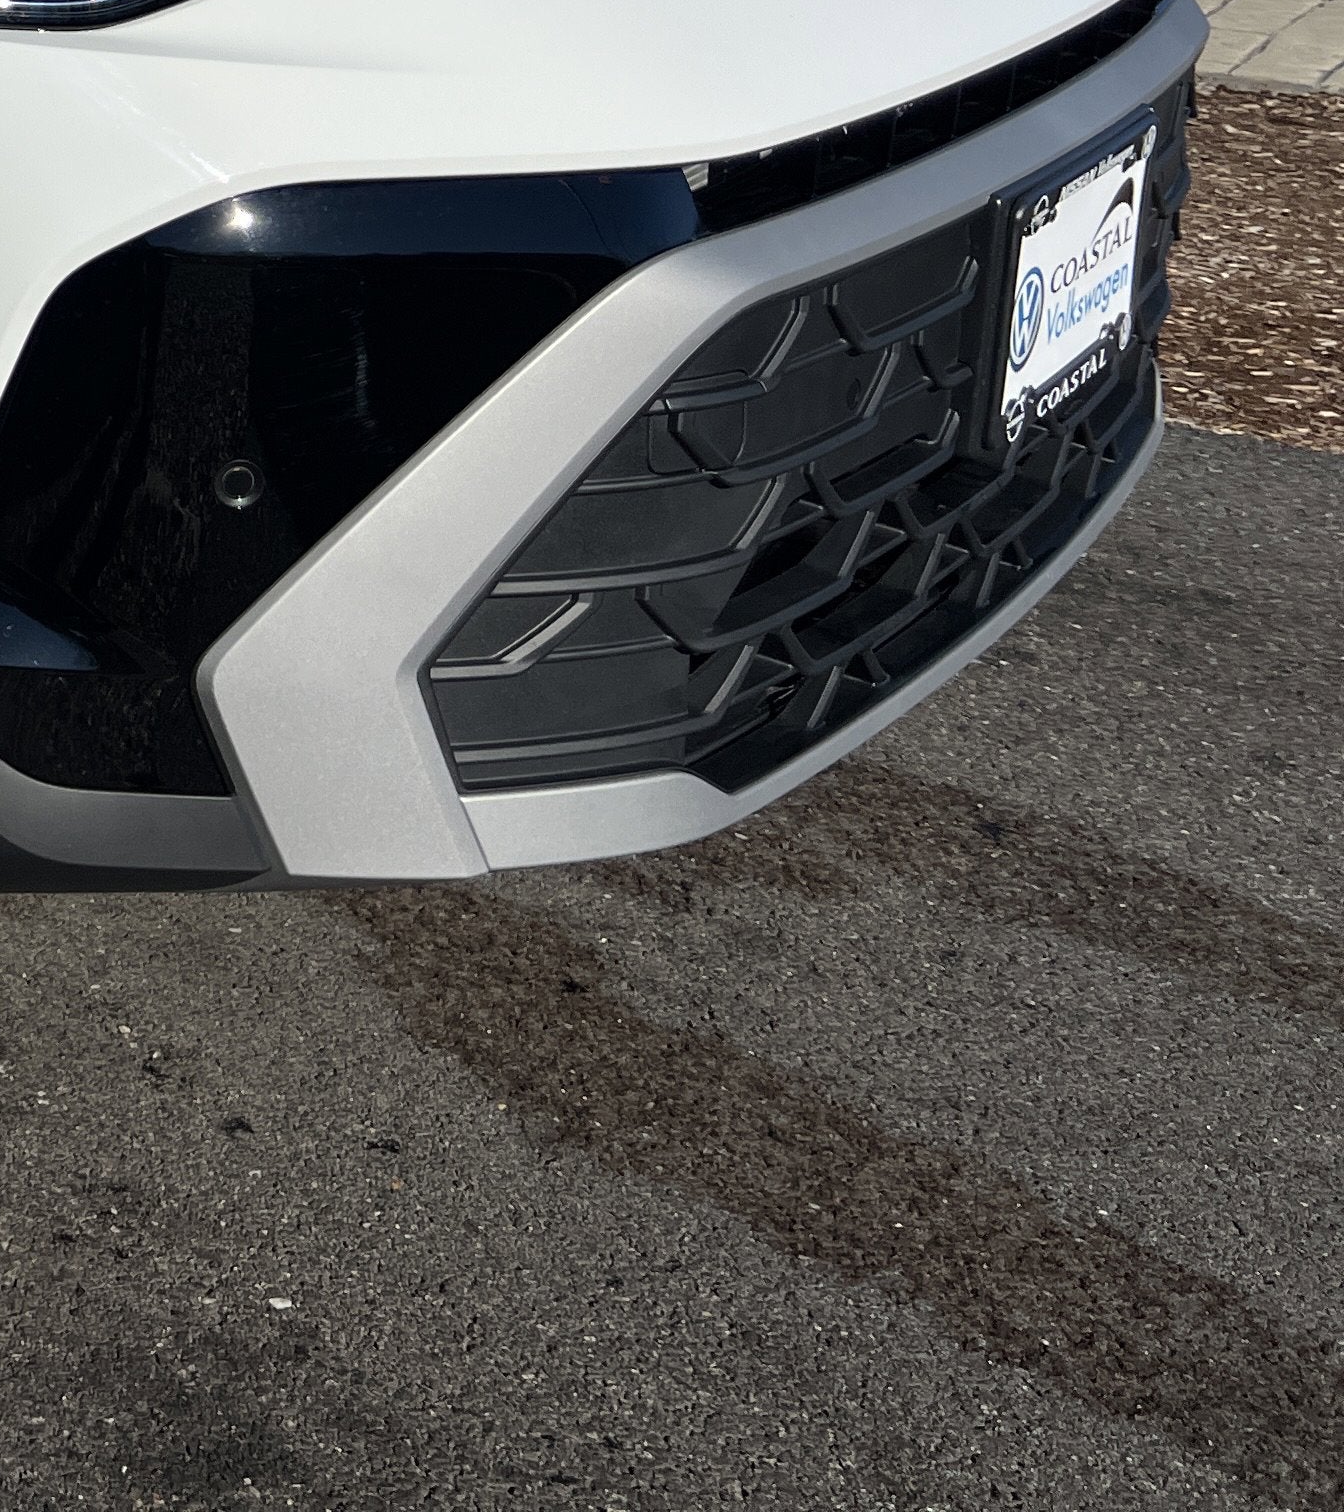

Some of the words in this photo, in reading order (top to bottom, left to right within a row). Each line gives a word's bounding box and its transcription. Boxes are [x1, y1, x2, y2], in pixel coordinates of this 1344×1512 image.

[1051, 217, 1132, 293] COASTAL
[1046, 263, 1129, 345] Volkswagen
[1037, 348, 1108, 418] COASTAL
